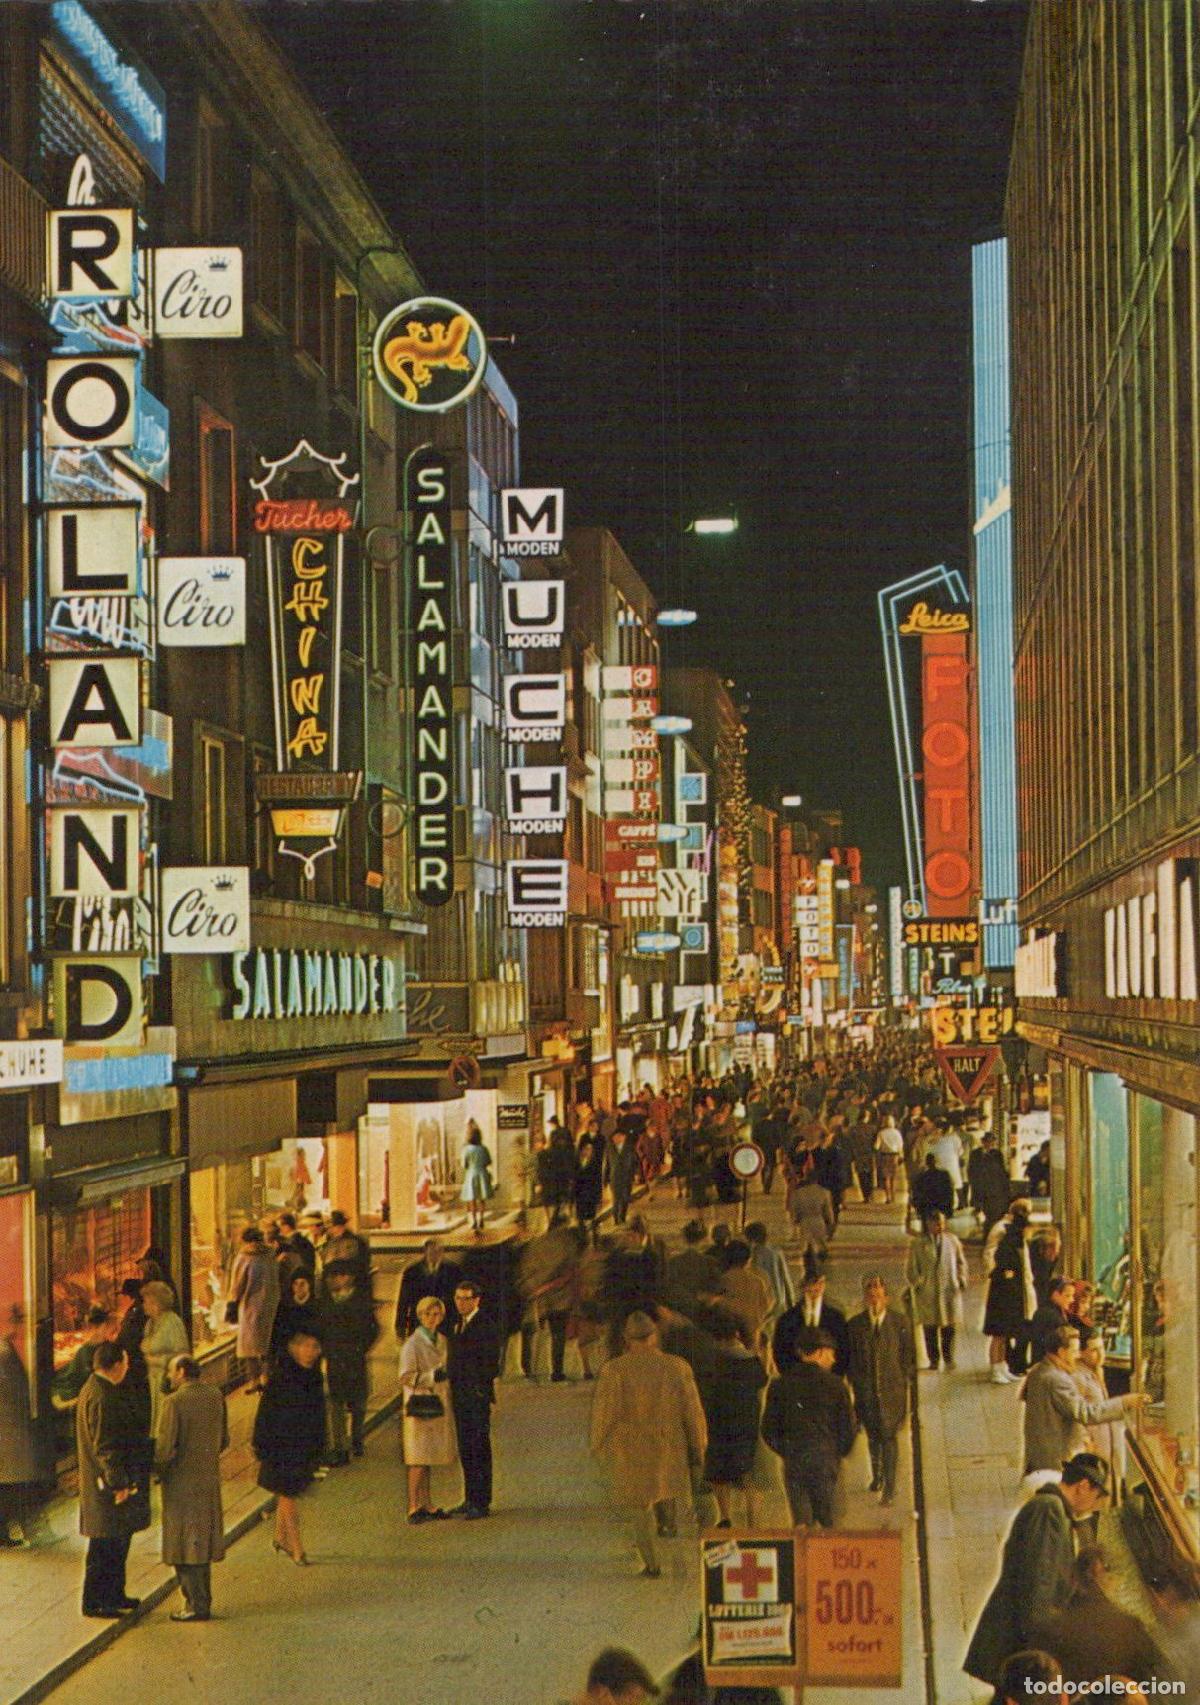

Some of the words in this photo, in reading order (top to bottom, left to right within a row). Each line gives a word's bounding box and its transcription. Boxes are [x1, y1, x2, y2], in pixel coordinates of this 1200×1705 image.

[161, 269, 232, 319] Ciro
[254, 499, 352, 533] Tucher
[507, 542, 559, 555] MODEN
[163, 578, 234, 628] Ciro
[899, 603, 970, 634] Leica
[52, 215, 133, 1041] ROLAND
[508, 634, 560, 647] MODEN
[285, 538, 329, 758] CHINA
[417, 467, 449, 892] SALAMANDER
[507, 495, 562, 905] MUCHE
[509, 728, 561, 741] MODEN
[922, 657, 970, 899] FOTO
[510, 820, 563, 833] MODEN
[167, 888, 239, 938] Ciro
[510, 913, 563, 926] MODEN
[905, 922, 978, 943] STEINS
[233, 947, 395, 1020] SALAMANDER
[953, 1057, 981, 1073] HALT
[828, 1634, 882, 1652] sofort
